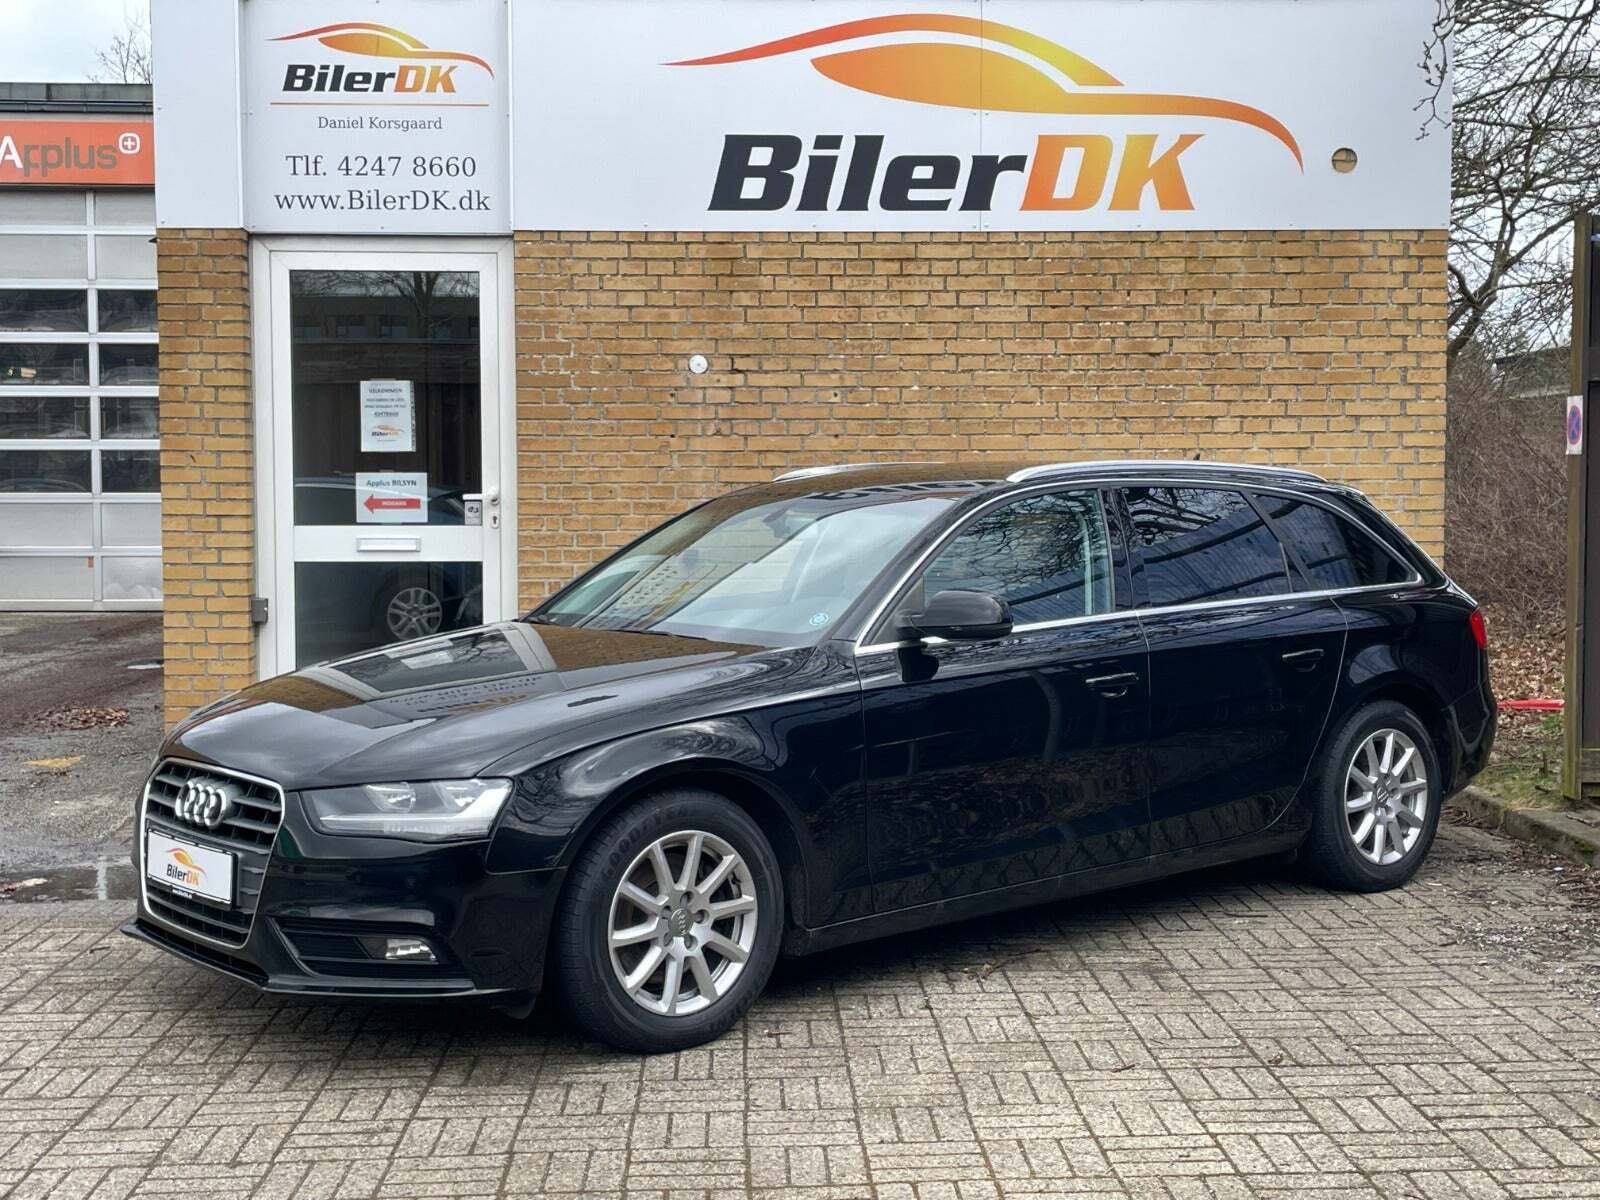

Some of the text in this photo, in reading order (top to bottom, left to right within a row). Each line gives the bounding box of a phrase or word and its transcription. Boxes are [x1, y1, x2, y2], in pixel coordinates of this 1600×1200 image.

[282, 64, 458, 93] BilerDK
[318, 116, 442, 132] Daniel Korsgaard
[286, 155, 477, 177] Tlf. 4247 8660
[707, 134, 1207, 212] BilerDK
[274, 189, 491, 211] www.BilerDK.dk
